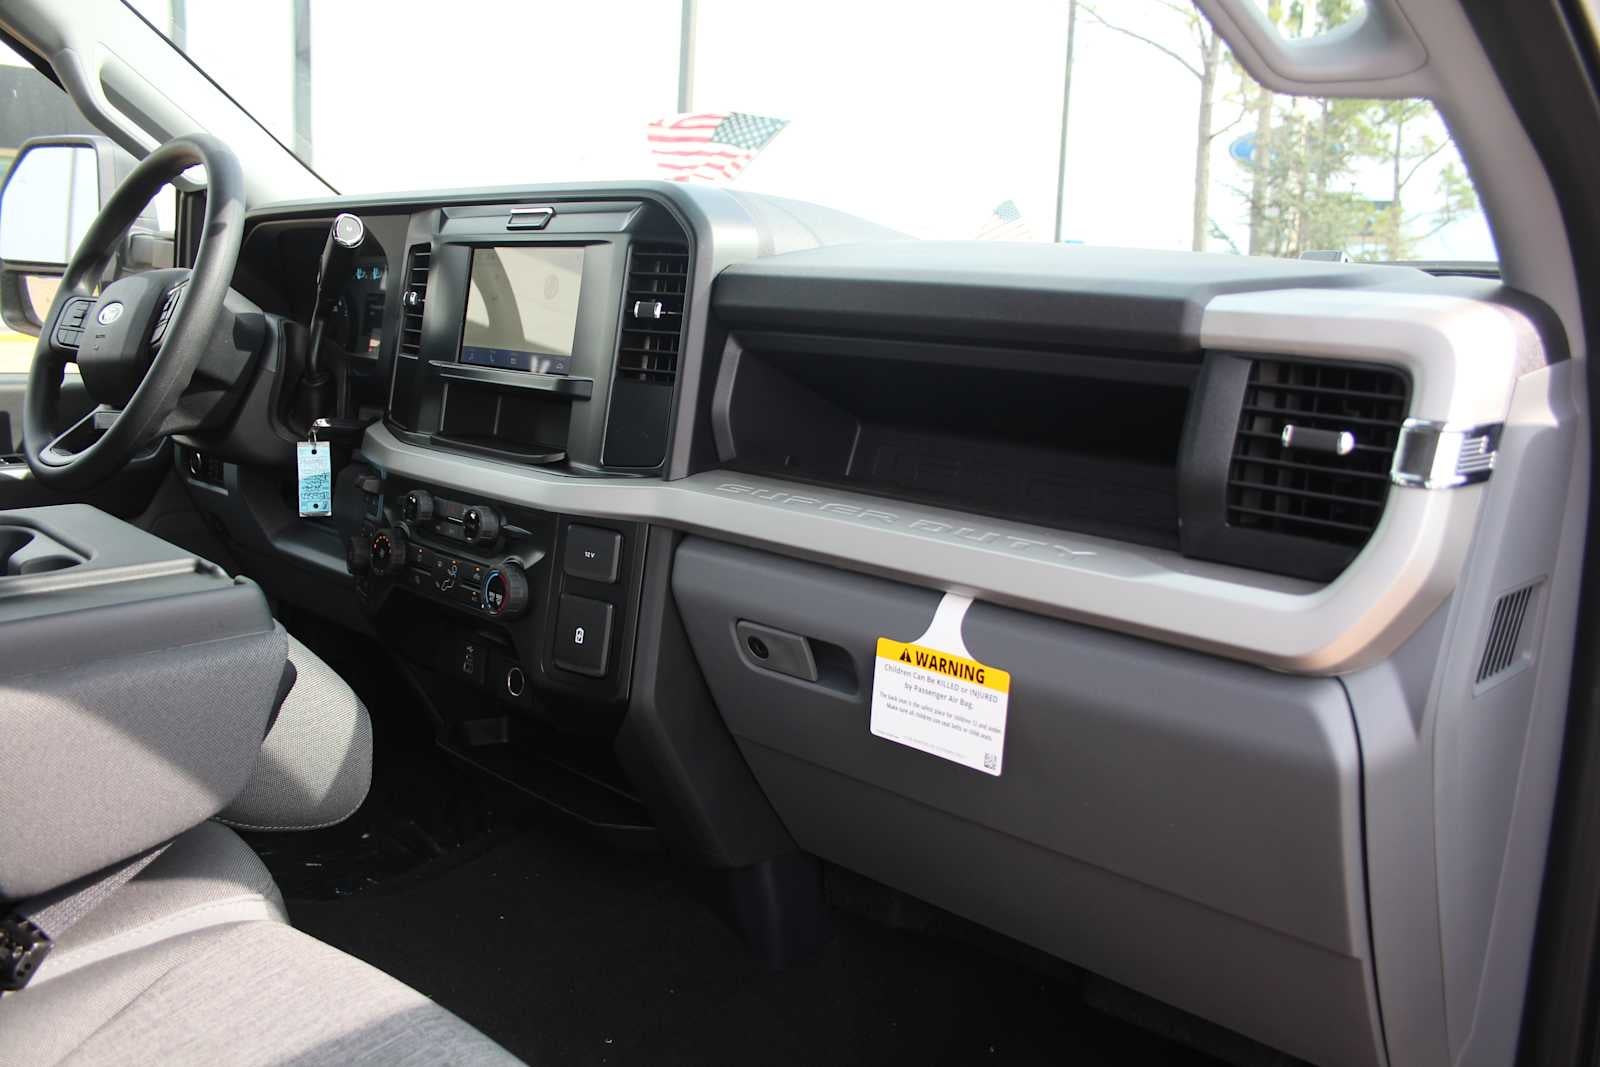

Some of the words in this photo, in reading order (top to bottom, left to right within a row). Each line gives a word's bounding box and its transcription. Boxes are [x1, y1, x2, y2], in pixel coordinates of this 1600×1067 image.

[715, 482, 899, 524] SUPER
[908, 519, 1097, 561] DUTY
[884, 664, 911, 677] Children
[913, 672, 925, 682] Can
[937, 678, 960, 691] KILLED
[970, 686, 998, 703] INJURED
[915, 650, 985, 684] WARNING
[905, 682, 912, 693] by
[914, 685, 946, 702] Passenger
[949, 693, 959, 703] Air
